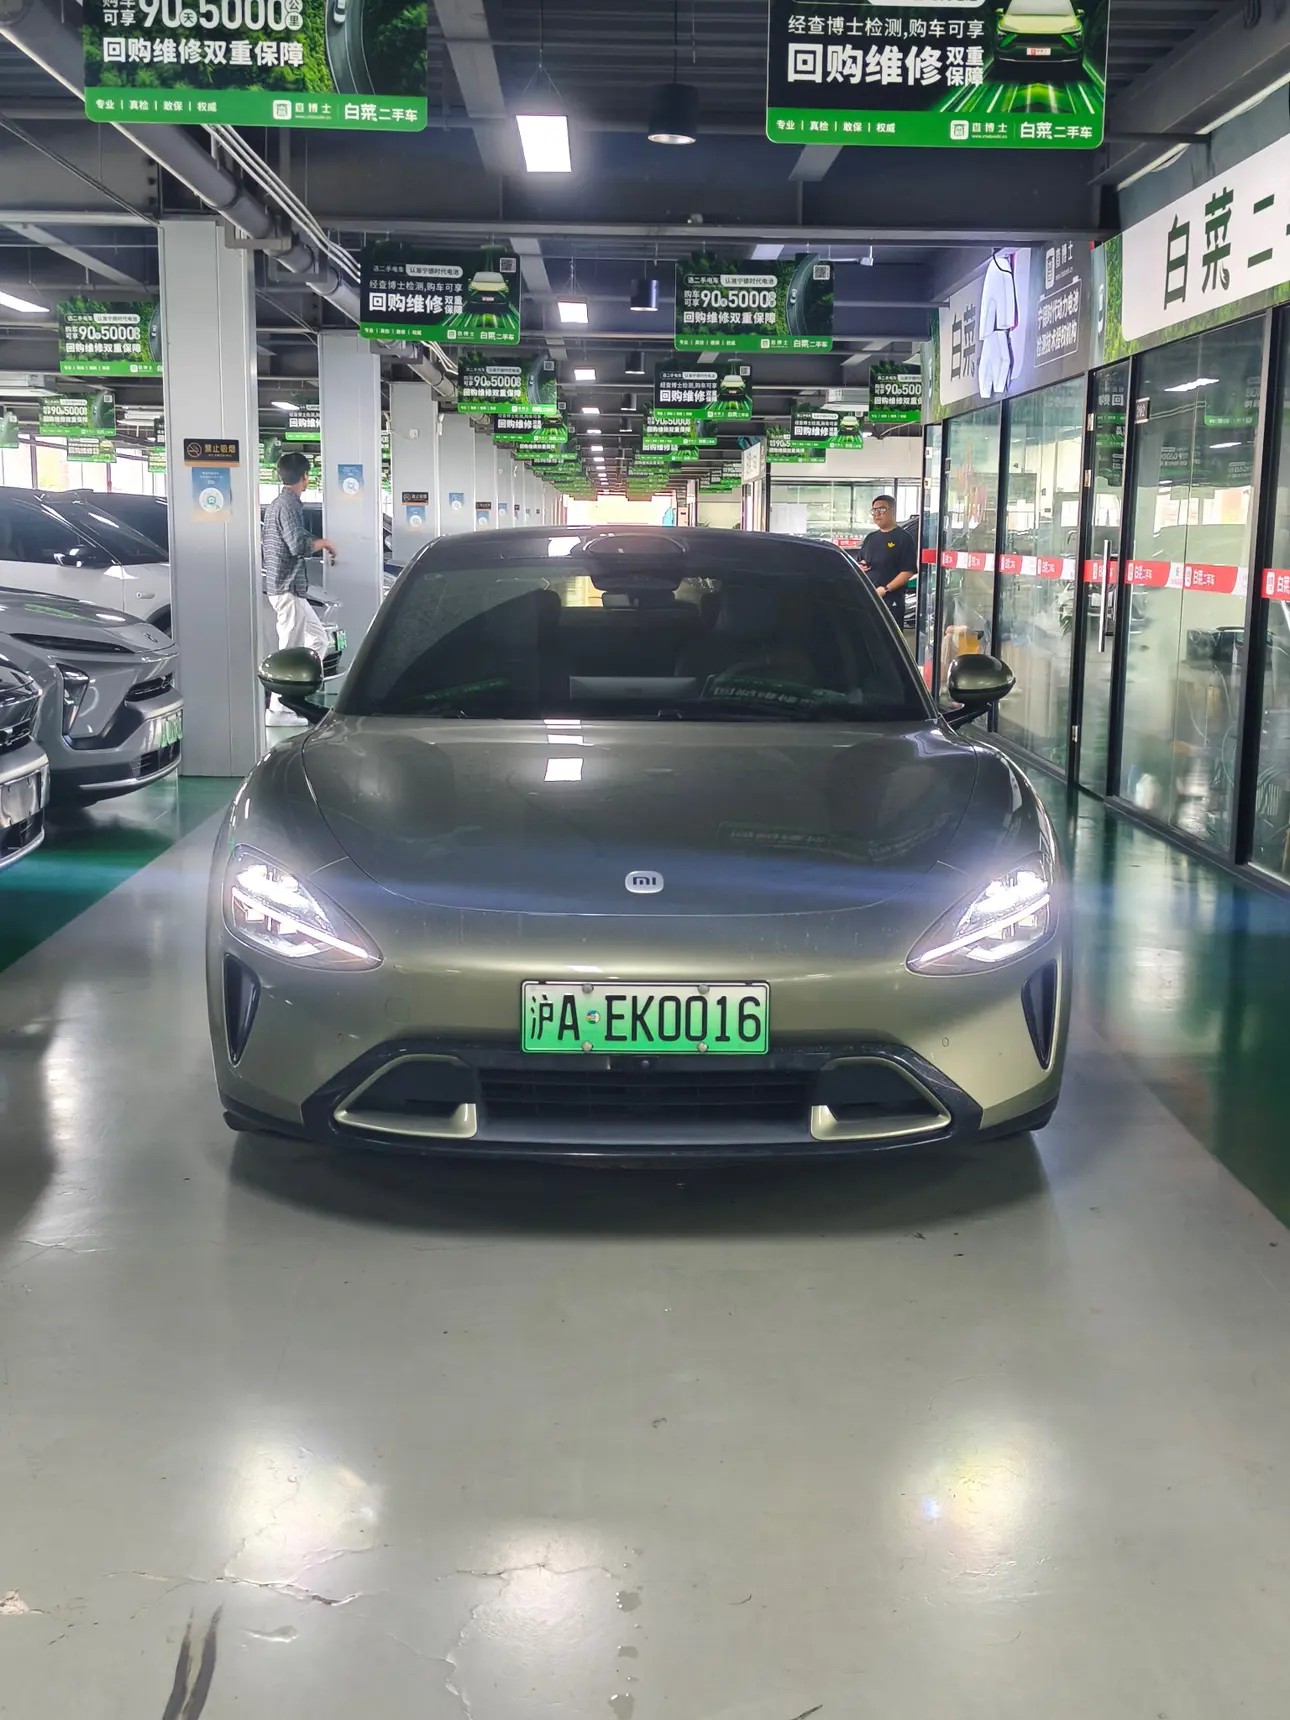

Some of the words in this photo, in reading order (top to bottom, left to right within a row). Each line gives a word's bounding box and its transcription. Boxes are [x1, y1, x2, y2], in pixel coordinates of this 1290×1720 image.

[103, 9, 136, 26] 可享
[787, 15, 985, 39] 经查博士检测,购车可享
[102, 37, 304, 67] 回购维修双重保障
[946, 46, 984, 66] 双重
[787, 43, 943, 86] 回购维修
[946, 66, 984, 87] 保障
[95, 99, 114, 110] 专业
[344, 102, 418, 122] 白菜二手车
[776, 119, 795, 130] 专业
[809, 120, 829, 131] 真检
[876, 122, 896, 133] 权威
[1020, 121, 1093, 140] 白菜二手车
[1164, 186, 1290, 310] 白菜二
[368, 292, 444, 314] 回购维修
[683, 311, 776, 324] 回购维修双重保障
[660, 390, 705, 402] 回购维修
[530, 993, 580, 1040] 沪A
[604, 994, 761, 1042] EK0016
